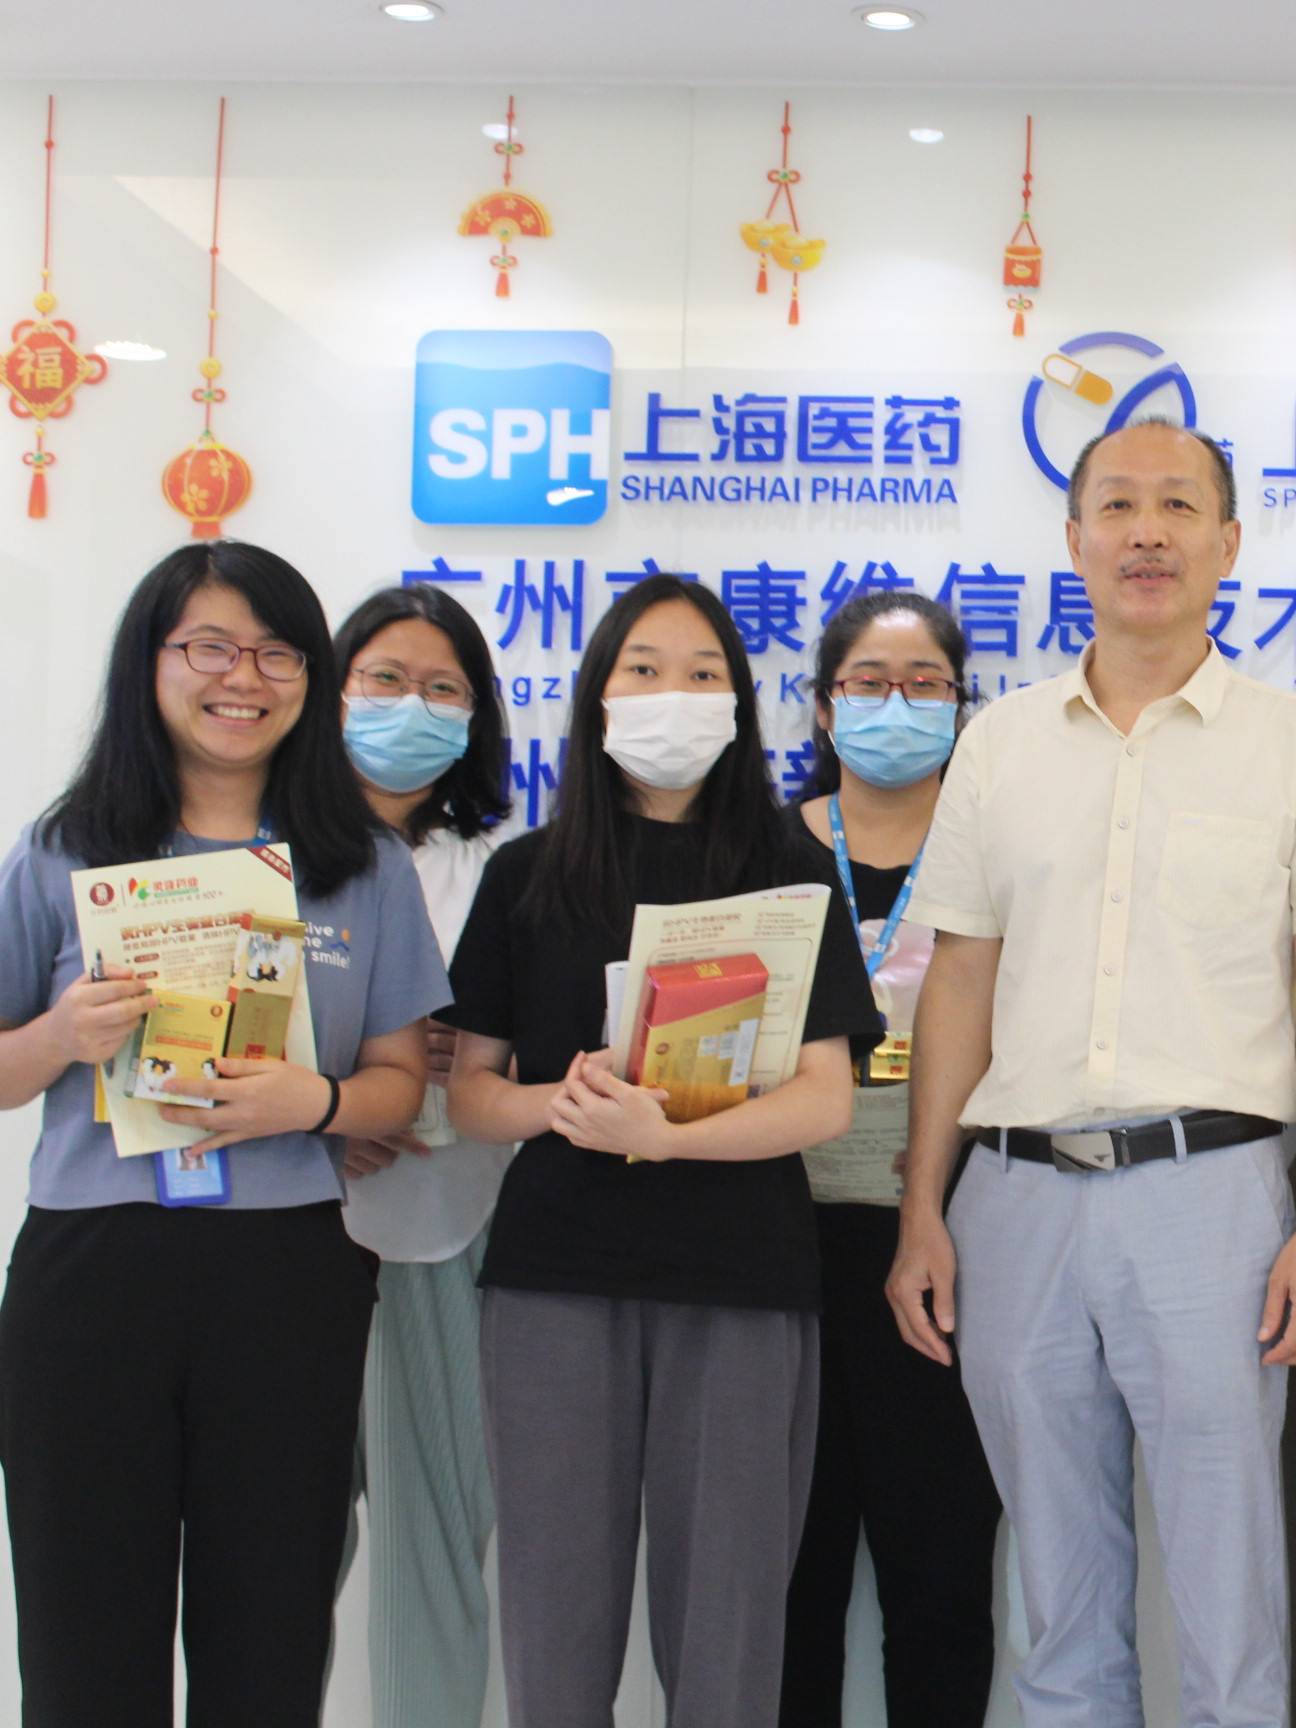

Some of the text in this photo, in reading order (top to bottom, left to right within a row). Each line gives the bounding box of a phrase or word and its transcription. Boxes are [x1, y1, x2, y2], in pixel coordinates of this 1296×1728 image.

[17, 346, 64, 389] 福
[428, 408, 610, 480] SPH
[624, 392, 960, 465] 上海医药
[620, 474, 958, 504] SHANGHAI PHARMA
[305, 921, 335, 937] ive
